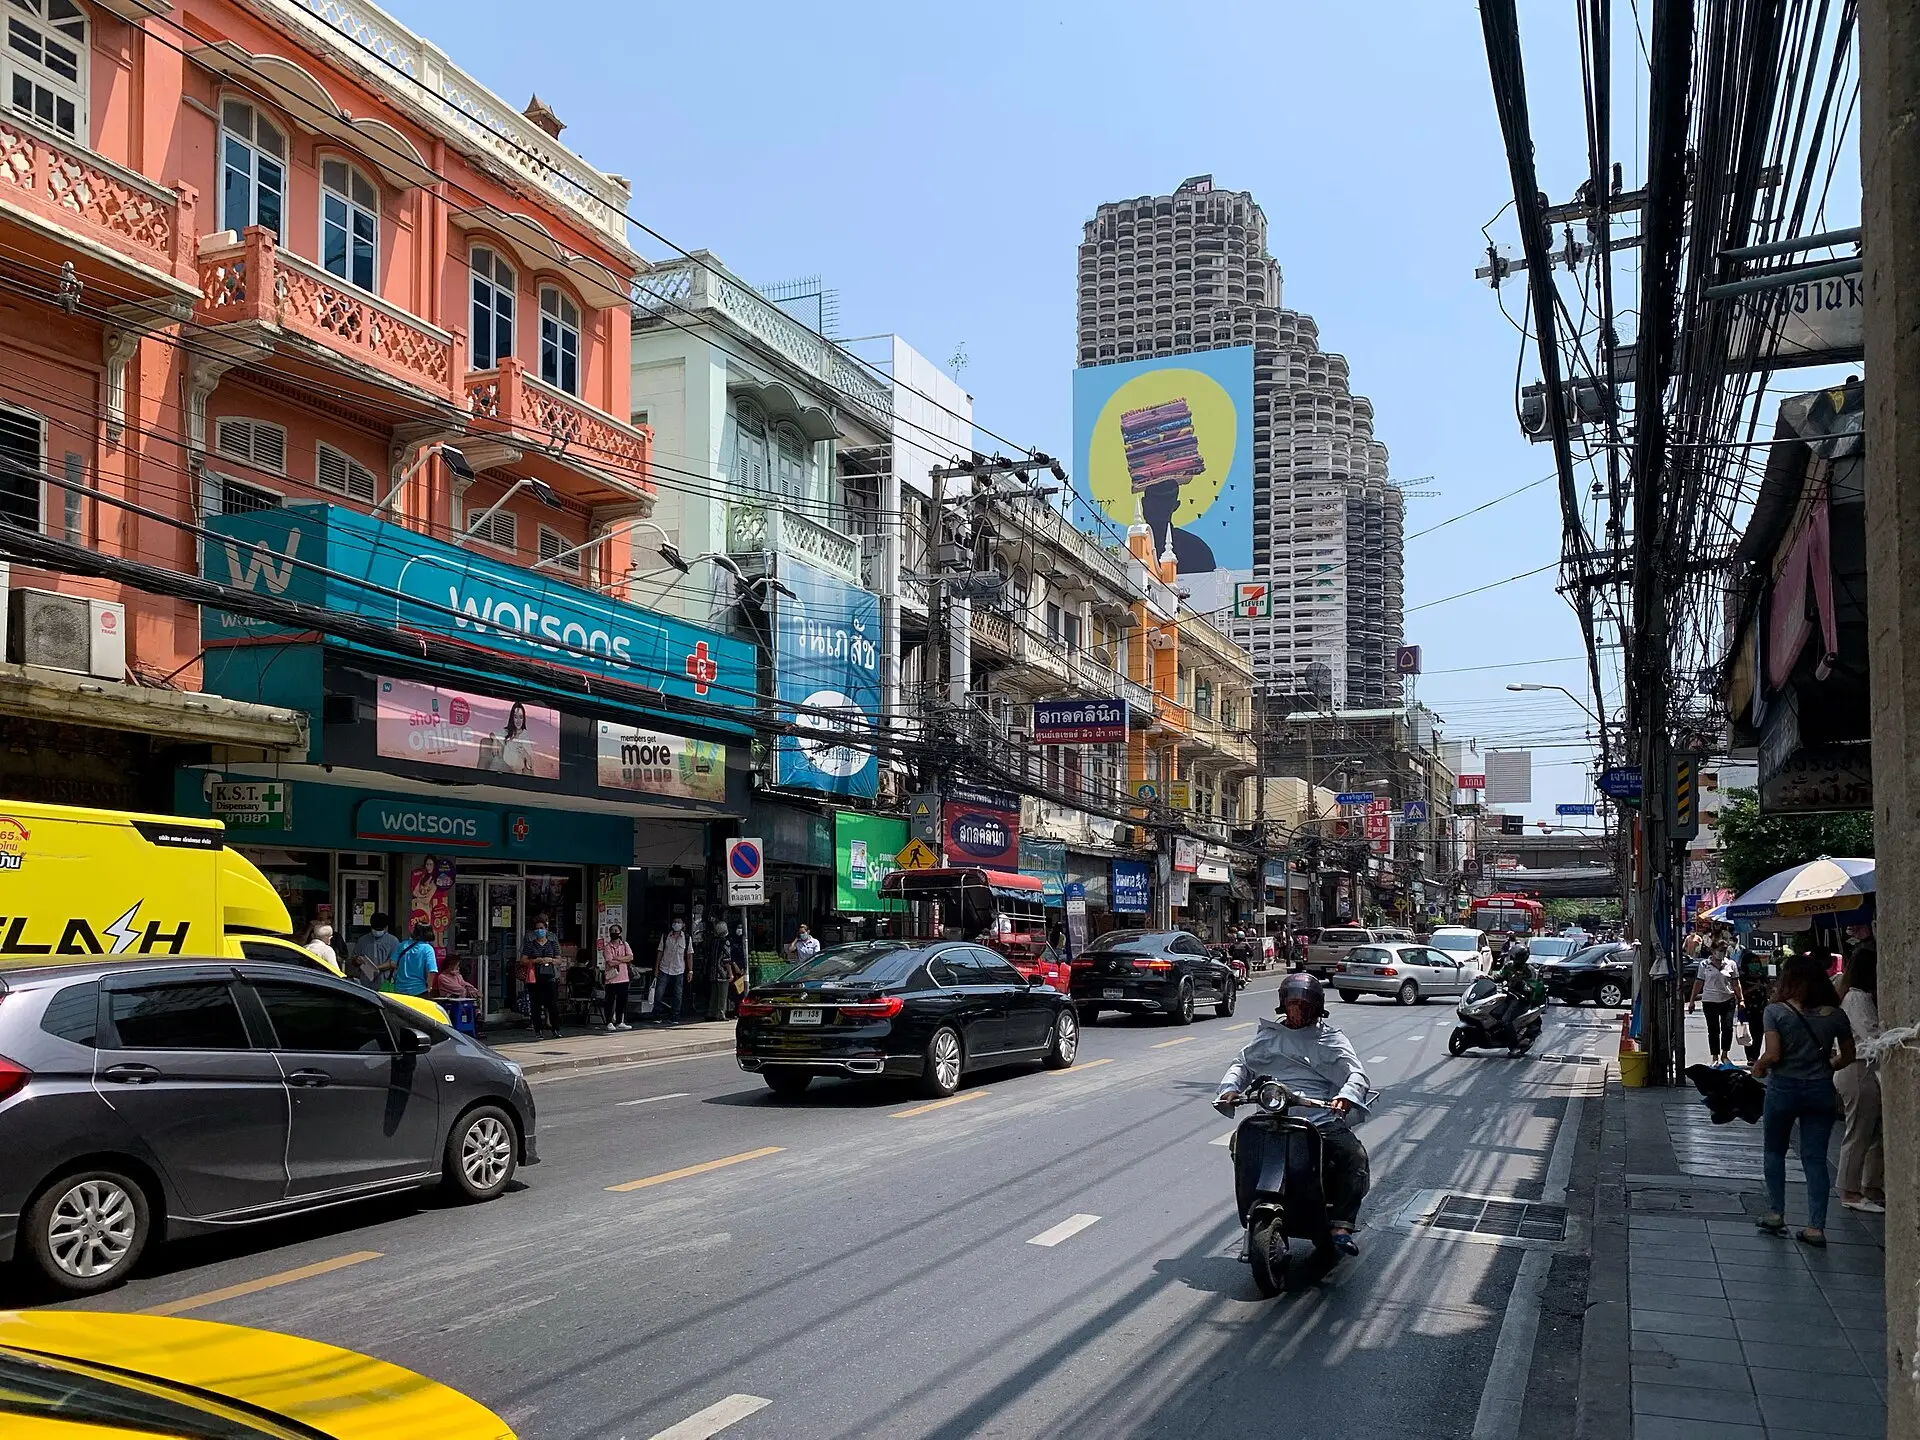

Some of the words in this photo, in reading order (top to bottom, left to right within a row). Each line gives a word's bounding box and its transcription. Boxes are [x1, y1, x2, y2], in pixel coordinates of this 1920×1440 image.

[449, 586, 632, 671] watsons
[409, 710, 440, 728] shop
[1039, 704, 1120, 724] สกลคลินิก
[408, 722, 473, 751] online
[620, 734, 647, 743] members
[646, 735, 657, 743] get
[621, 744, 671, 766] more
[216, 786, 259, 801] K.S.T.
[216, 801, 260, 811] Dispensary
[225, 813, 270, 823] ขายยา
[381, 811, 476, 837] watsons
[0, 831, 15, 843] 65
[959, 821, 1005, 847] สกลคลินิก
[0, 897, 192, 954] LASH
